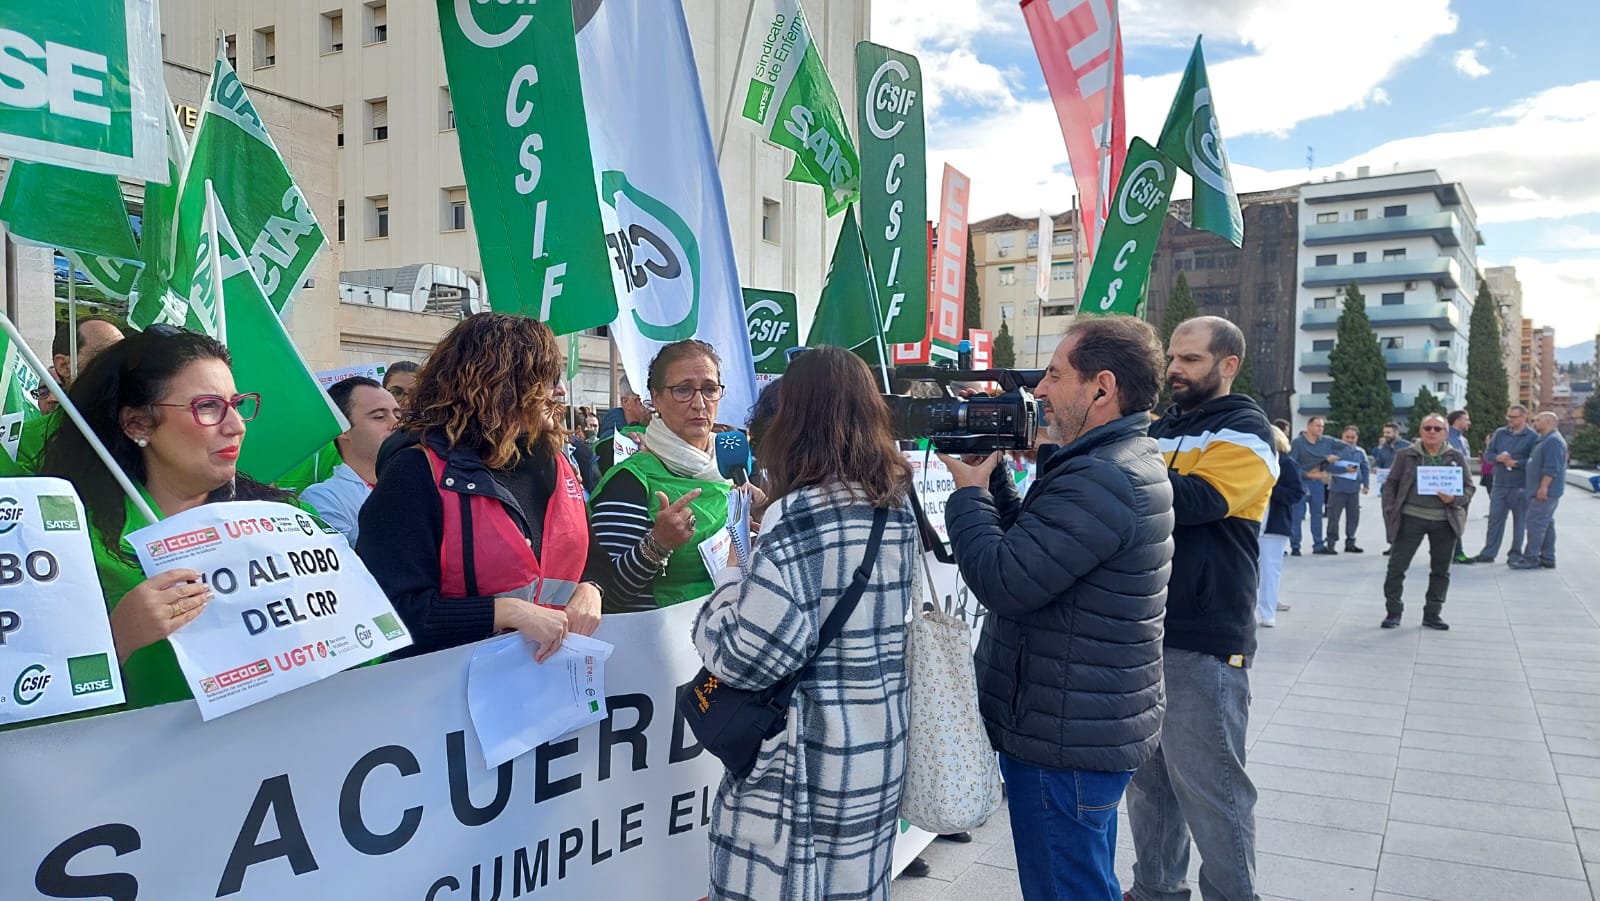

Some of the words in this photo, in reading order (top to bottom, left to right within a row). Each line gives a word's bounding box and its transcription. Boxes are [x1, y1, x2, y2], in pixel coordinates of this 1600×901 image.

[755, 13, 786, 78] Sindicato
[768, 66, 782, 83] de
[748, 318, 790, 342] CSIF
[926, 480, 935, 493] AL
[46, 520, 78, 529] SATSE
[224, 518, 261, 539] UGT
[248, 555, 290, 588] AL
[288, 547, 340, 577] ROBO
[241, 597, 307, 636] DEL
[306, 590, 339, 617] CRP
[274, 644, 315, 671] UGT
[74, 679, 109, 693] SATSE
[668, 785, 710, 836] EL
